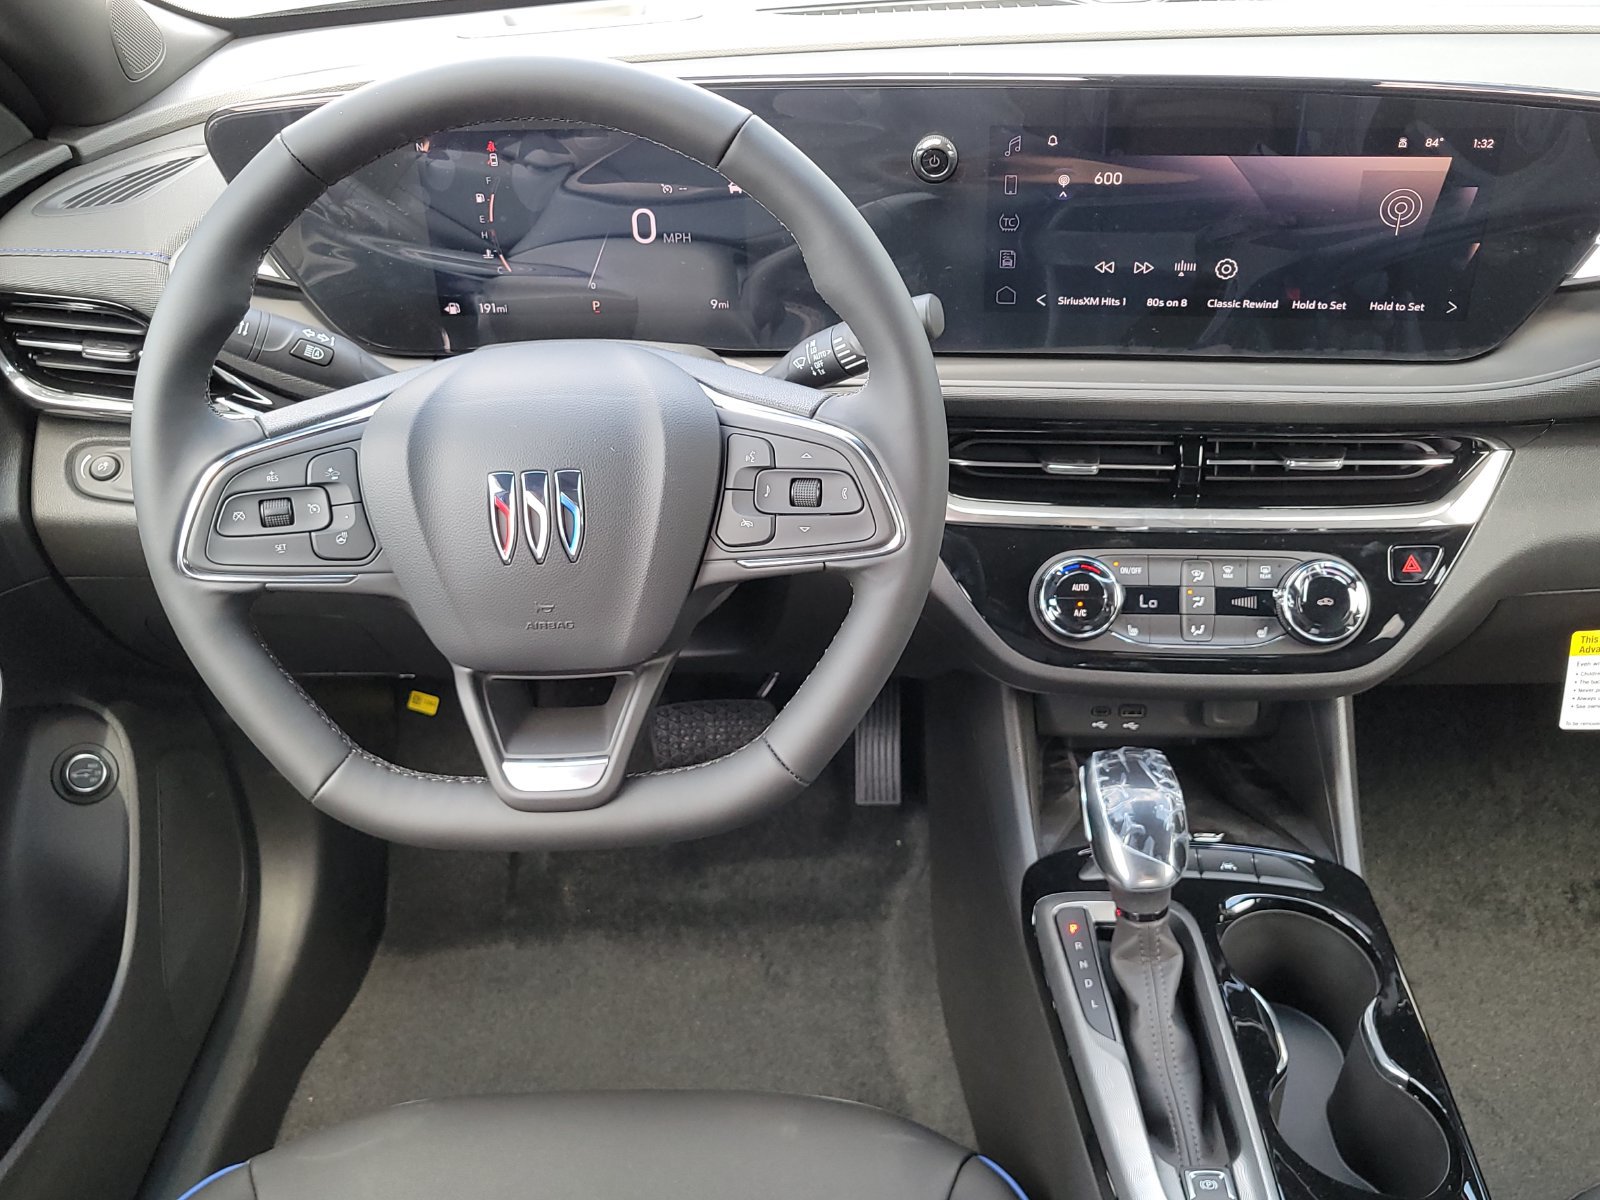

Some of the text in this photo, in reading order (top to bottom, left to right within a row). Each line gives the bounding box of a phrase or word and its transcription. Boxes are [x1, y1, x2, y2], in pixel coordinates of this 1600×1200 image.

[1473, 138, 1495, 149] 1:32
[485, 176, 491, 185] F
[1094, 172, 1123, 185] 600
[479, 215, 485, 223] E
[631, 207, 657, 244] 0
[481, 231, 488, 239] H
[663, 232, 692, 243] MPH
[592, 300, 601, 311] P
[1057, 296, 1100, 306] SiriusXM
[1101, 297, 1121, 306] Hits
[1146, 298, 1164, 307] 80s
[1180, 298, 1188, 307] 8
[1207, 299, 1279, 309] Classic Rewind
[1292, 300, 1347, 310] Hold to Set
[1369, 301, 1425, 311] Hold to Set
[1120, 566, 1142, 575] ON/OFF
[1072, 583, 1089, 592] AUTO
[1073, 609, 1088, 617] A/C
[526, 620, 575, 631] AIRBAG
[1580, 635, 1599, 644] This
[1069, 923, 1078, 934] P
[1075, 941, 1083, 951] R
[1079, 960, 1088, 969] N
[1084, 978, 1093, 988] D
[1091, 999, 1099, 1008] L
